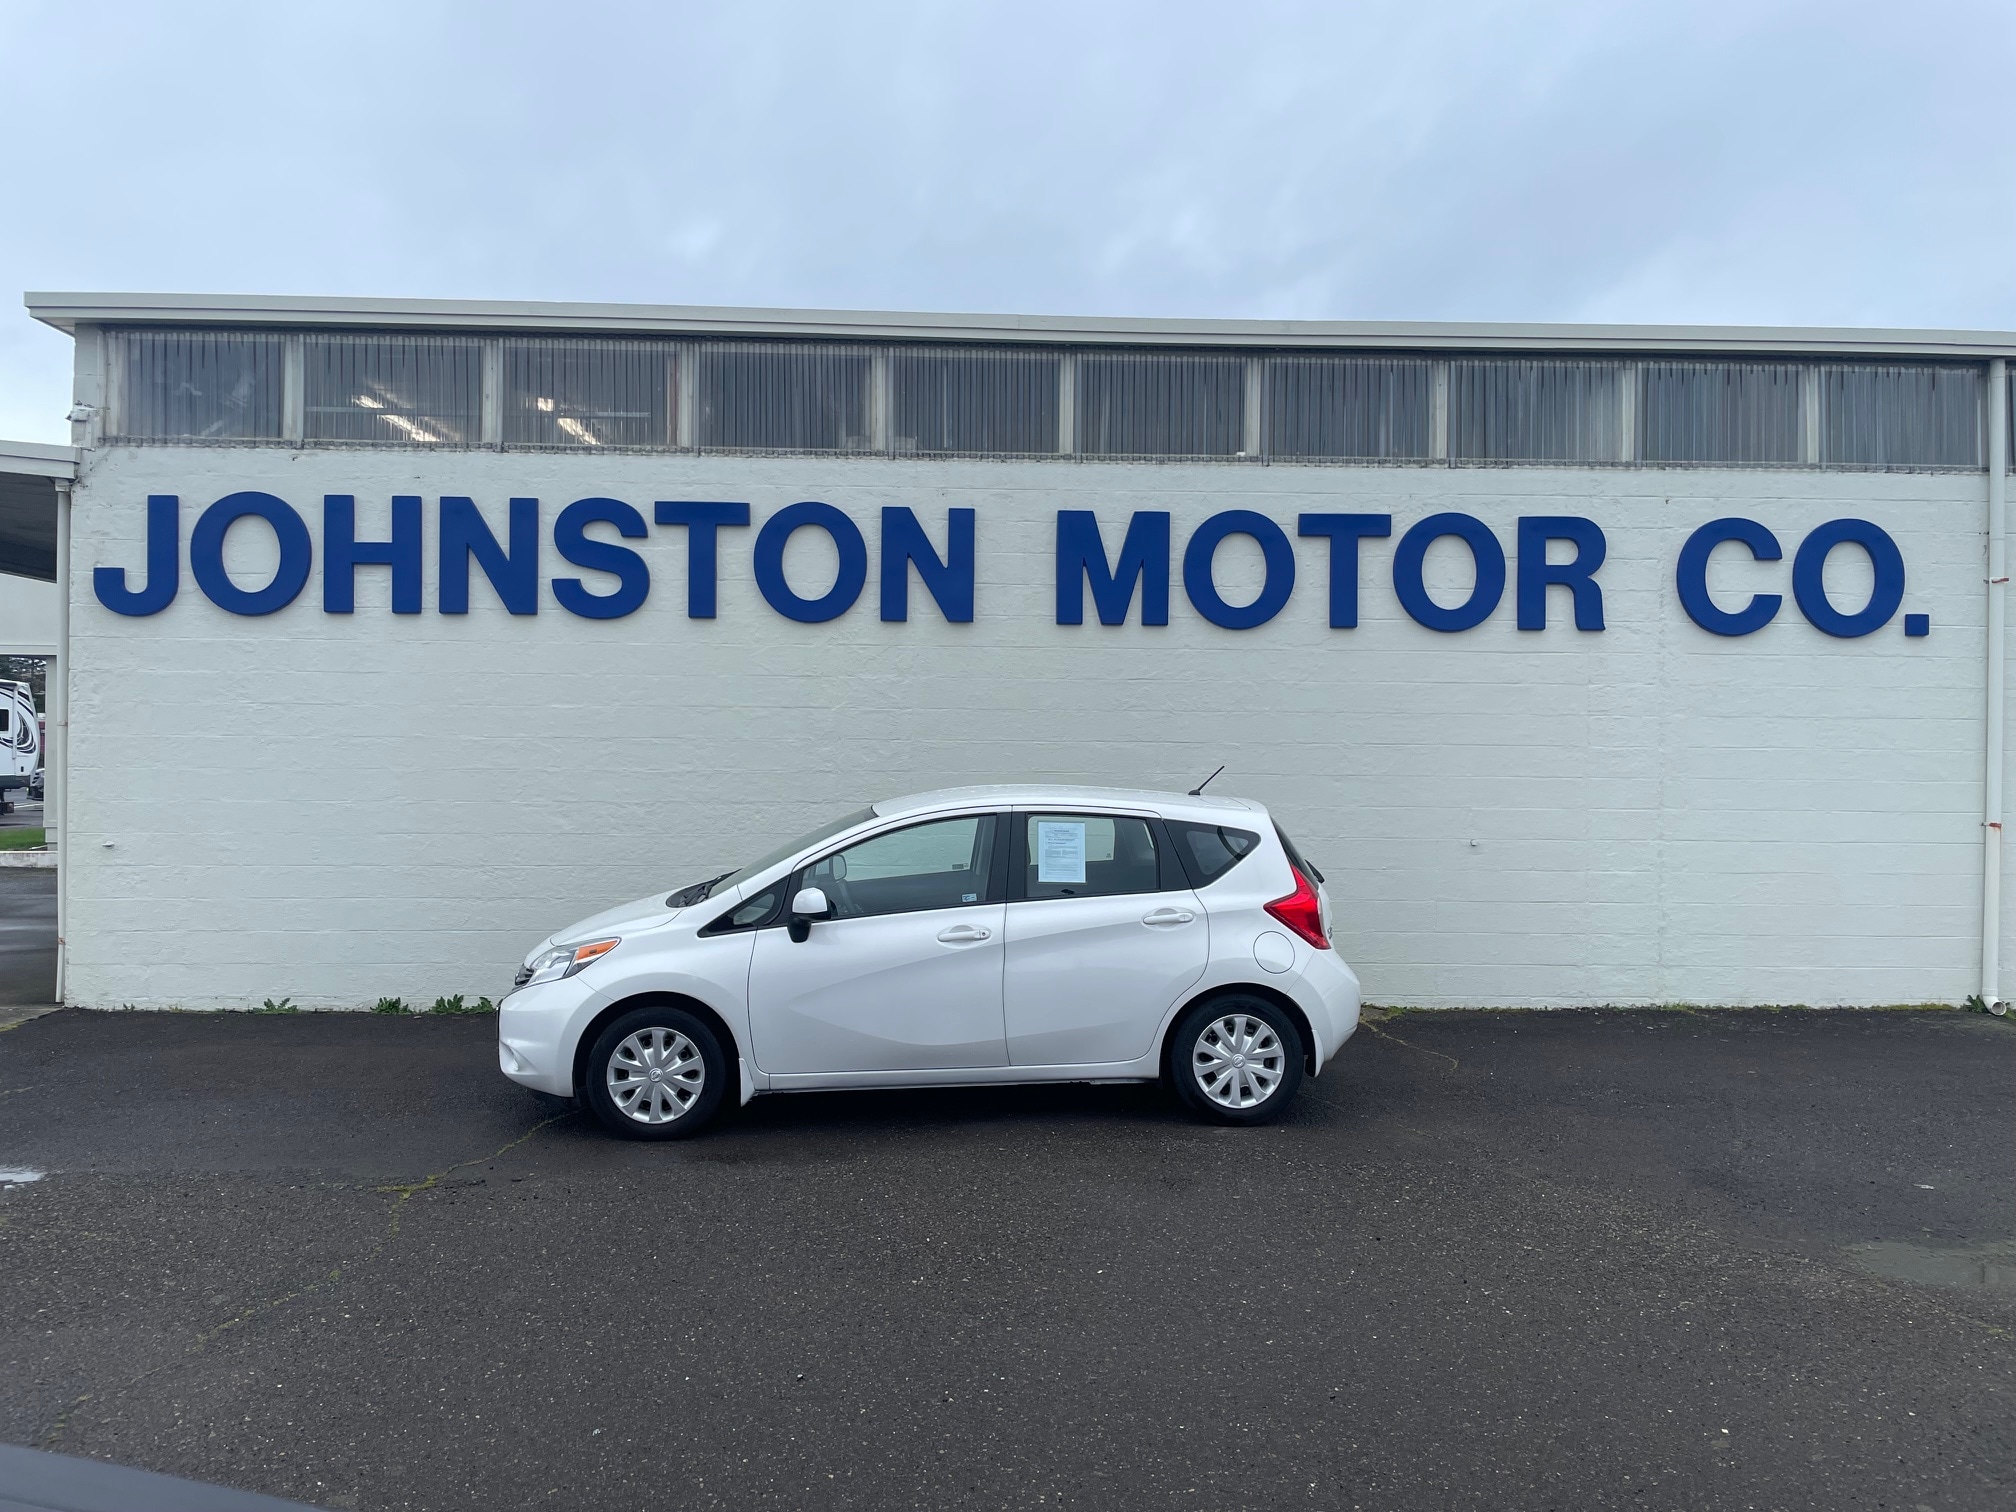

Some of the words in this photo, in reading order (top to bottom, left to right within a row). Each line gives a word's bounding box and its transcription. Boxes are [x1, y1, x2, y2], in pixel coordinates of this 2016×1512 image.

[94, 491, 975, 625] JOHNSTON
[1056, 510, 1607, 633] MOTOR
[1676, 517, 1930, 639] CO.
